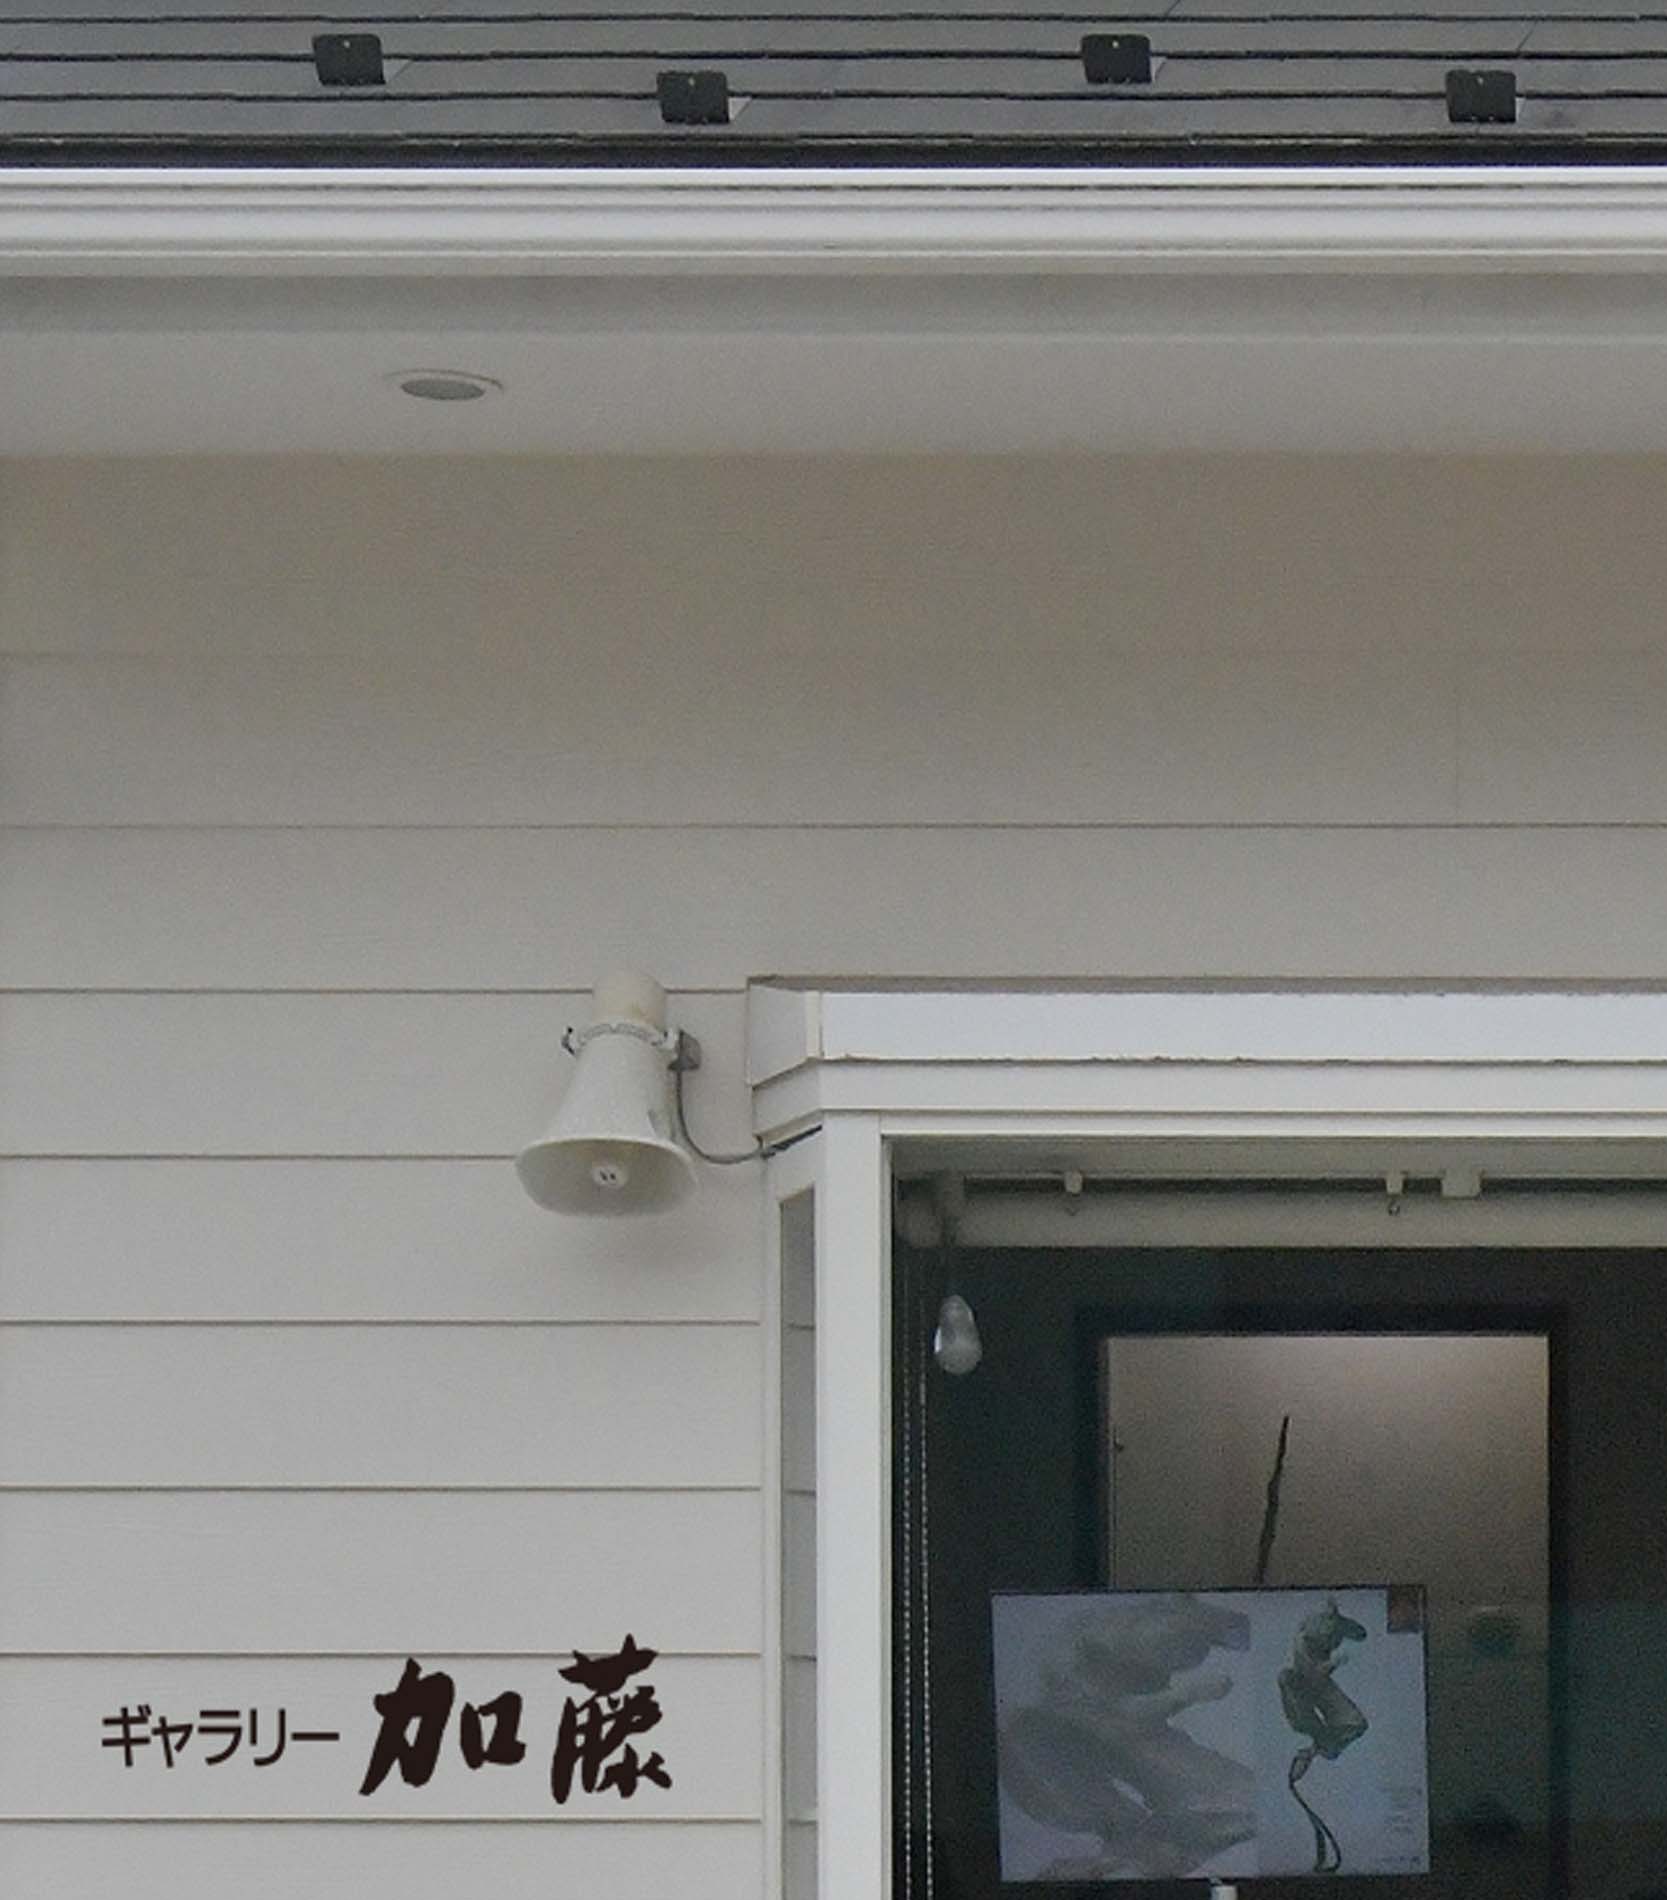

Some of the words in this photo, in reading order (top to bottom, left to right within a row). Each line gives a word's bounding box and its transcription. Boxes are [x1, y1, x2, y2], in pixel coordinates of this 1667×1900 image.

[101, 1704, 340, 1768] ギャラリー
[359, 1633, 673, 1805] 加藤
